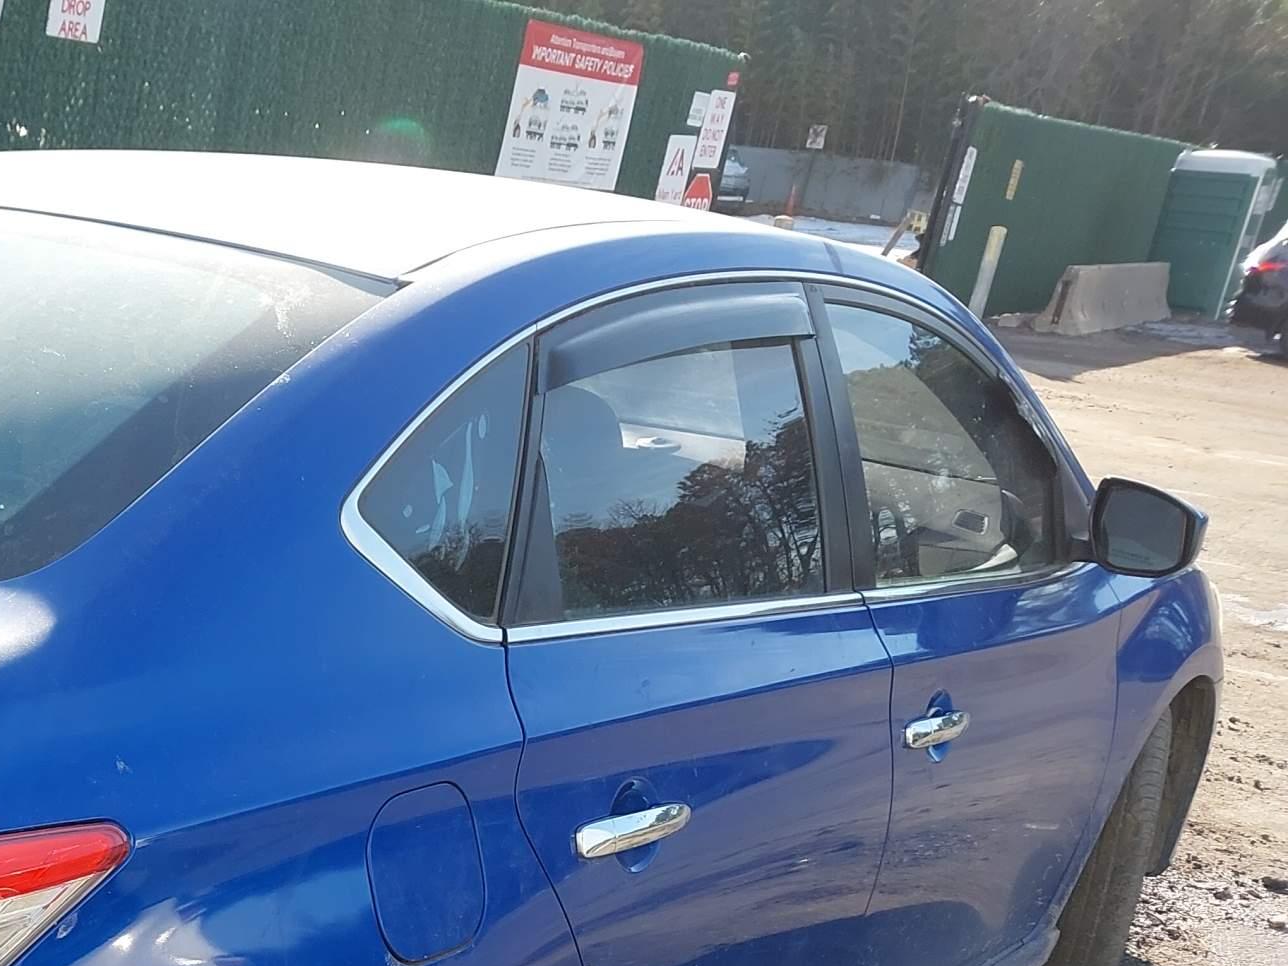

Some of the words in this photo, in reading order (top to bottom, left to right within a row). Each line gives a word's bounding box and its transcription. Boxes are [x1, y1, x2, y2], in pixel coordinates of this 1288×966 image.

[61, 0, 91, 16] DROP
[58, 20, 88, 41] AREA
[532, 44, 575, 67] IMPORTANT
[575, 54, 603, 72] SAFETY
[601, 59, 634, 78] POLICIES
